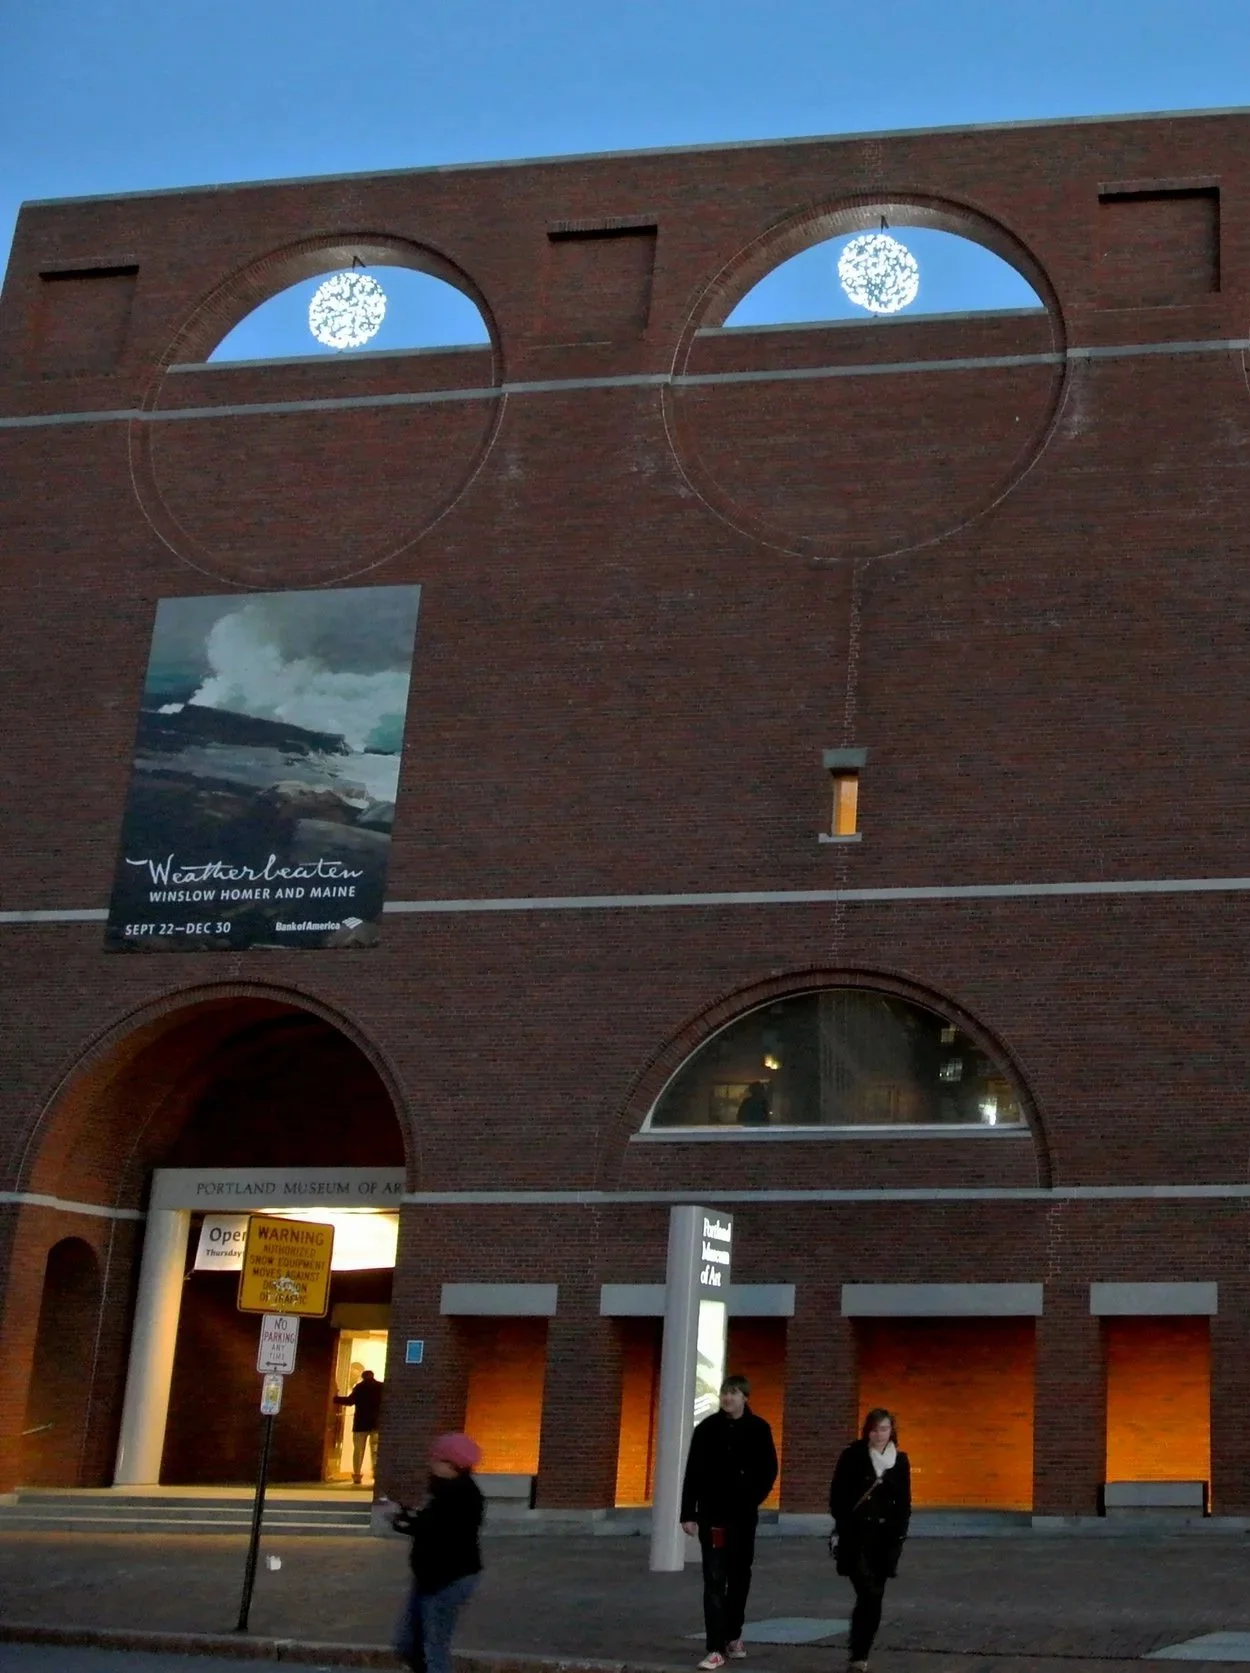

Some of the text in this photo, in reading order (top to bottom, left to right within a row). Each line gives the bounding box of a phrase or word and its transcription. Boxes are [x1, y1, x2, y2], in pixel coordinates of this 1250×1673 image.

[125, 853, 364, 885] Weatherbeaten
[149, 885, 356, 903] WINSLOW HOMER AND MAINE
[125, 923, 156, 936] SEPT
[215, 921, 232, 933] 30
[196, 1182, 402, 1195] PORTLAND MUSEUM OF AR
[258, 1225, 325, 1246] WARNING
[263, 1243, 316, 1258] AUTHORIZED
[250, 1254, 325, 1270] SNOW EQUIPMENT
[252, 1266, 320, 1281] MOVES AGAINST
[274, 1318, 288, 1331] NO
[264, 1332, 295, 1345] PARKING
[271, 1343, 286, 1352] ANY
